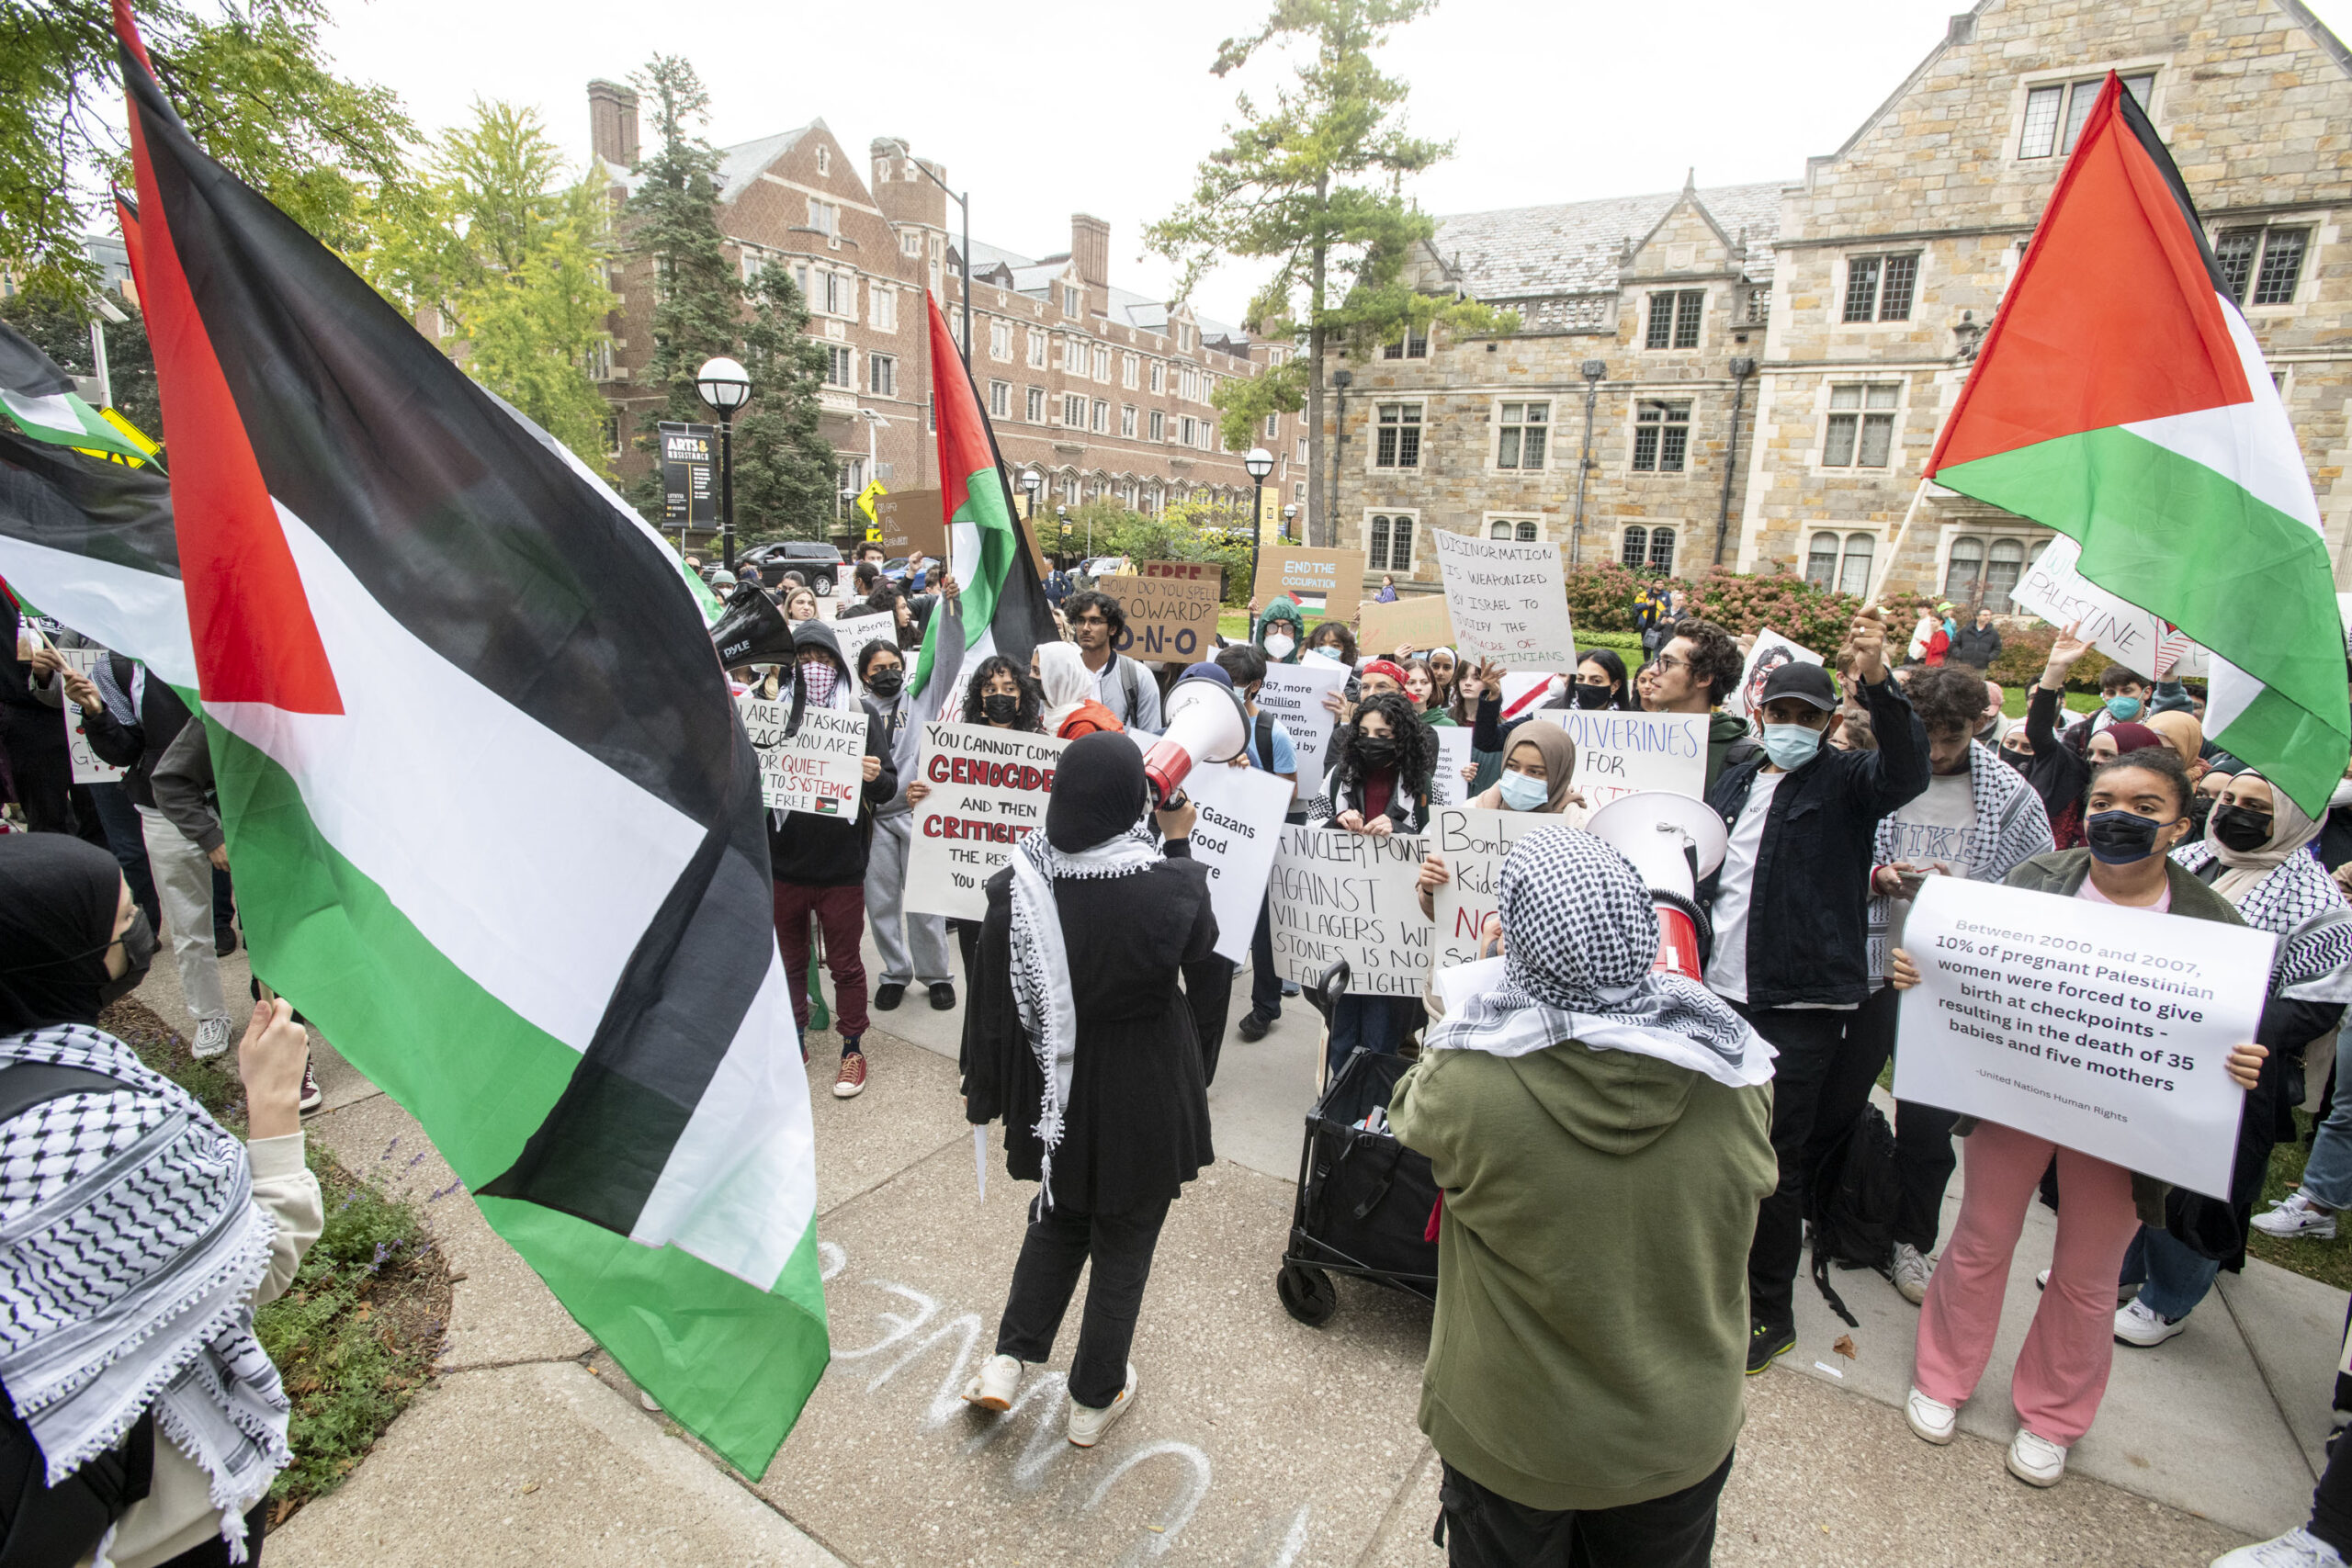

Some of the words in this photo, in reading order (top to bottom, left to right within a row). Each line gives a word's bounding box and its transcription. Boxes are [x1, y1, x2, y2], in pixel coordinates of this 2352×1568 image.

[668, 450, 709, 461] RESISTANCE
[1439, 534, 1554, 560] DISINORMATION
[1284, 560, 1311, 573] END
[1312, 562, 1337, 574] THE
[1445, 564, 1462, 580] IS
[1467, 570, 1547, 586] WEAPONIZED
[1102, 579, 1128, 592] HOW
[1137, 581, 1156, 594] DO
[1160, 583, 1183, 597] YOU
[1186, 585, 1217, 601] SPELL
[1281, 576, 1337, 588] OCCUPATION
[1118, 596, 1212, 623] OWARD?
[1468, 596, 1510, 612] ISRAEL
[1520, 598, 1539, 610] TO
[2025, 571, 2146, 655] PALESTINE
[857, 620, 893, 635] deserves
[1114, 625, 1197, 655] O-N-O
[1500, 622, 1528, 634] THE
[723, 639, 751, 659] PYLE
[1517, 638, 1537, 649] OF
[1264, 694, 1301, 706] million
[1283, 685, 1312, 694] more
[746, 705, 779, 725] ARE
[783, 709, 814, 728] NT
[814, 714, 866, 737] ASKING
[1281, 714, 1307, 723] men,
[796, 732, 821, 749] YOU
[824, 738, 858, 757] ARE
[926, 725, 959, 748] YOU
[963, 735, 1024, 757] CANNOT
[1303, 741, 1317, 753] by
[782, 754, 831, 776] QUIET
[927, 753, 1056, 794] GENOCIDE
[1587, 751, 1624, 778] FOR
[770, 773, 786, 789] TO
[786, 775, 854, 800] SYSTEMIC
[775, 793, 808, 808] FREE
[960, 796, 992, 813] AND
[998, 801, 1037, 818] THEN
[923, 814, 1035, 845] CRITICIZ
[1202, 807, 1256, 840] Gazans
[1190, 829, 1228, 854] food
[1295, 828, 1366, 869] NUCLER
[1373, 836, 1430, 863] POWE
[1894, 822, 1975, 865] NIKE
[949, 848, 980, 864] THE
[985, 852, 1008, 867] RES
[951, 873, 975, 889] YOU
[1271, 863, 1381, 914] AGAINST
[1273, 901, 1385, 944] VILLAGERS
[1273, 931, 1346, 964] STONES
[1363, 946, 1379, 967] IS
[1955, 919, 2034, 943] Between
[2039, 935, 2093, 954] 2000
[2098, 948, 2137, 963] and
[2142, 954, 2201, 978] 2007,
[1289, 958, 1323, 987] FAI
[1935, 935, 1973, 953] 10%
[1978, 945, 1999, 957] of
[2001, 950, 2091, 976] pregnant
[2095, 965, 2214, 1000] Palestinian
[1938, 959, 2001, 981] women
[2007, 974, 2052, 992] were
[2058, 981, 2124, 1007] forced
[2130, 997, 2152, 1011] to
[2156, 1003, 2203, 1023] give
[1961, 982, 2002, 1004] birth
[2007, 997, 2026, 1010] at
[2030, 1001, 2154, 1037] checkpoints
[1939, 998, 2012, 1030] resulting
[2017, 1018, 2032, 1033] in
[2038, 1024, 2070, 1042] the
[2075, 1033, 2133, 1057] death
[2140, 1050, 2164, 1064] of
[2167, 1053, 2195, 1070] 35
[1950, 1018, 2004, 1045] babies
[2007, 1039, 2041, 1056] and
[2045, 1047, 2082, 1067] five
[2086, 1061, 2175, 1091] mothers
[2014, 1079, 2052, 1099] Nations
[2053, 1093, 2091, 1111] Human
[2093, 1106, 2129, 1123] Rights
